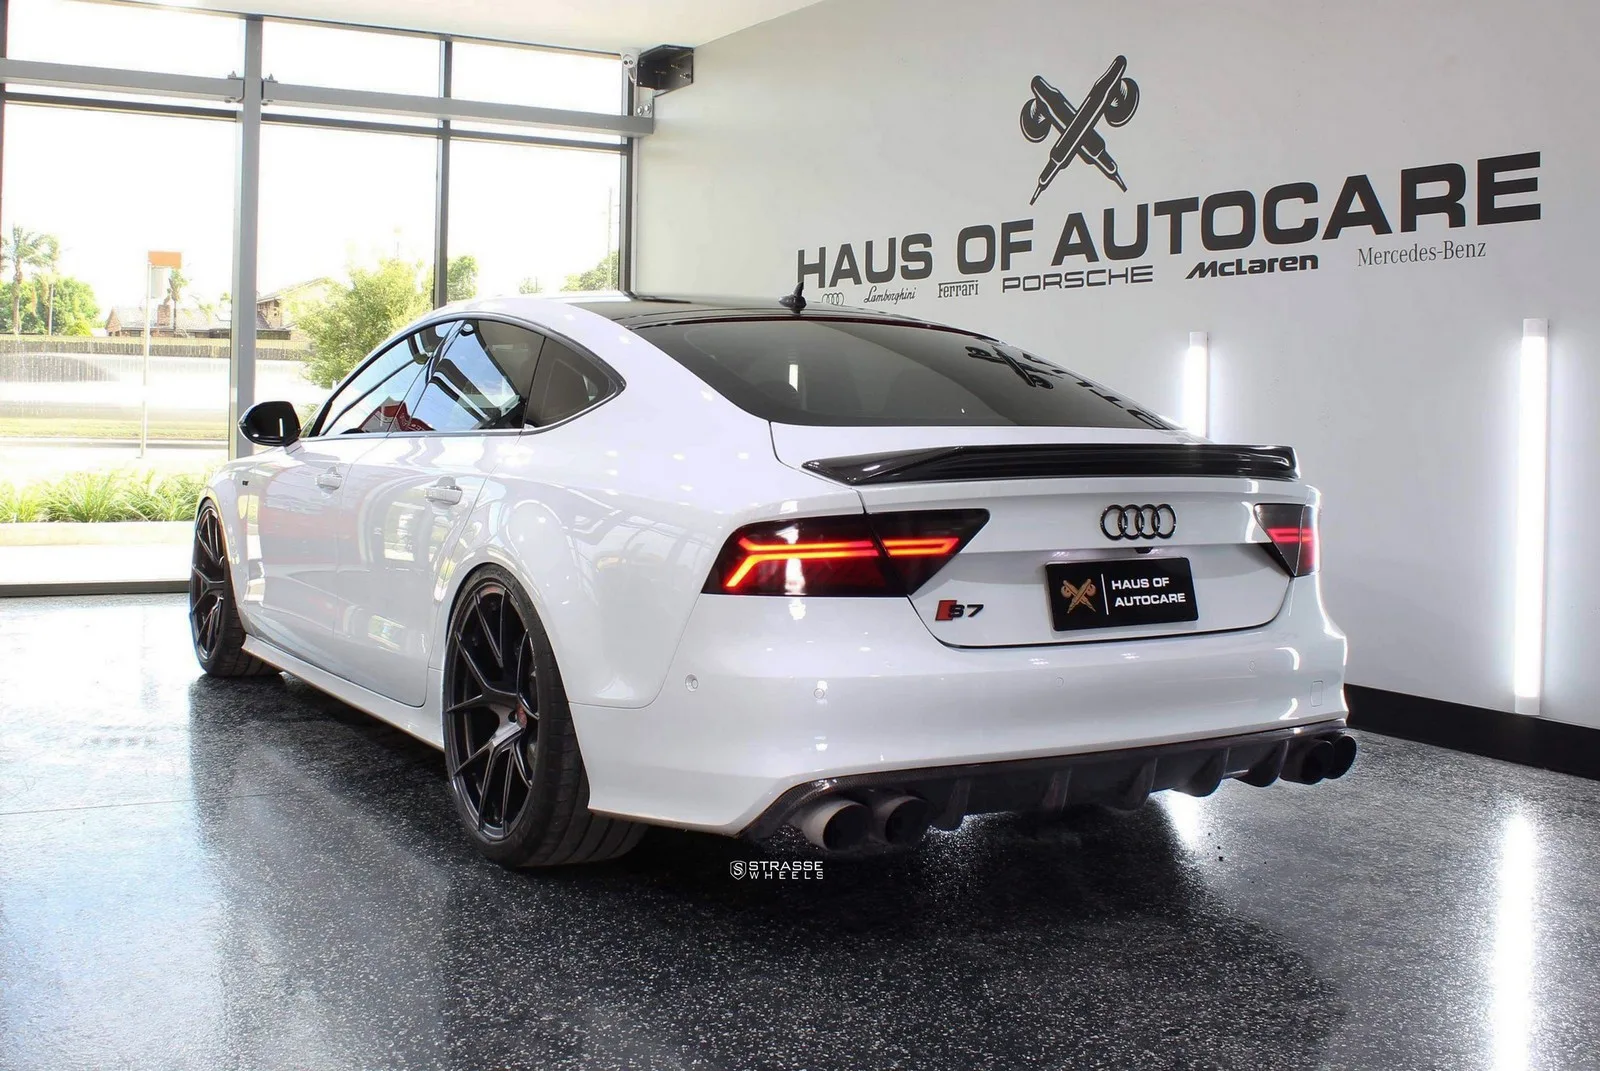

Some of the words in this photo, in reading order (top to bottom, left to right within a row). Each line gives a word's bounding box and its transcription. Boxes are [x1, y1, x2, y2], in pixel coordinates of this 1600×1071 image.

[797, 232, 933, 289] HAUS
[956, 218, 1034, 276] OF
[1050, 150, 1542, 267] AUTOCARE
[1357, 240, 1487, 267] Mercedes-Benz
[1185, 254, 1319, 280] McLaren
[937, 280, 979, 298] Ferrari
[1002, 264, 1154, 294] PORSCHE
[863, 285, 917, 305] Lamborghini
[1111, 577, 1150, 590] HAUS
[1152, 576, 1170, 588] OF
[1114, 592, 1187, 608] AUTOCARE
